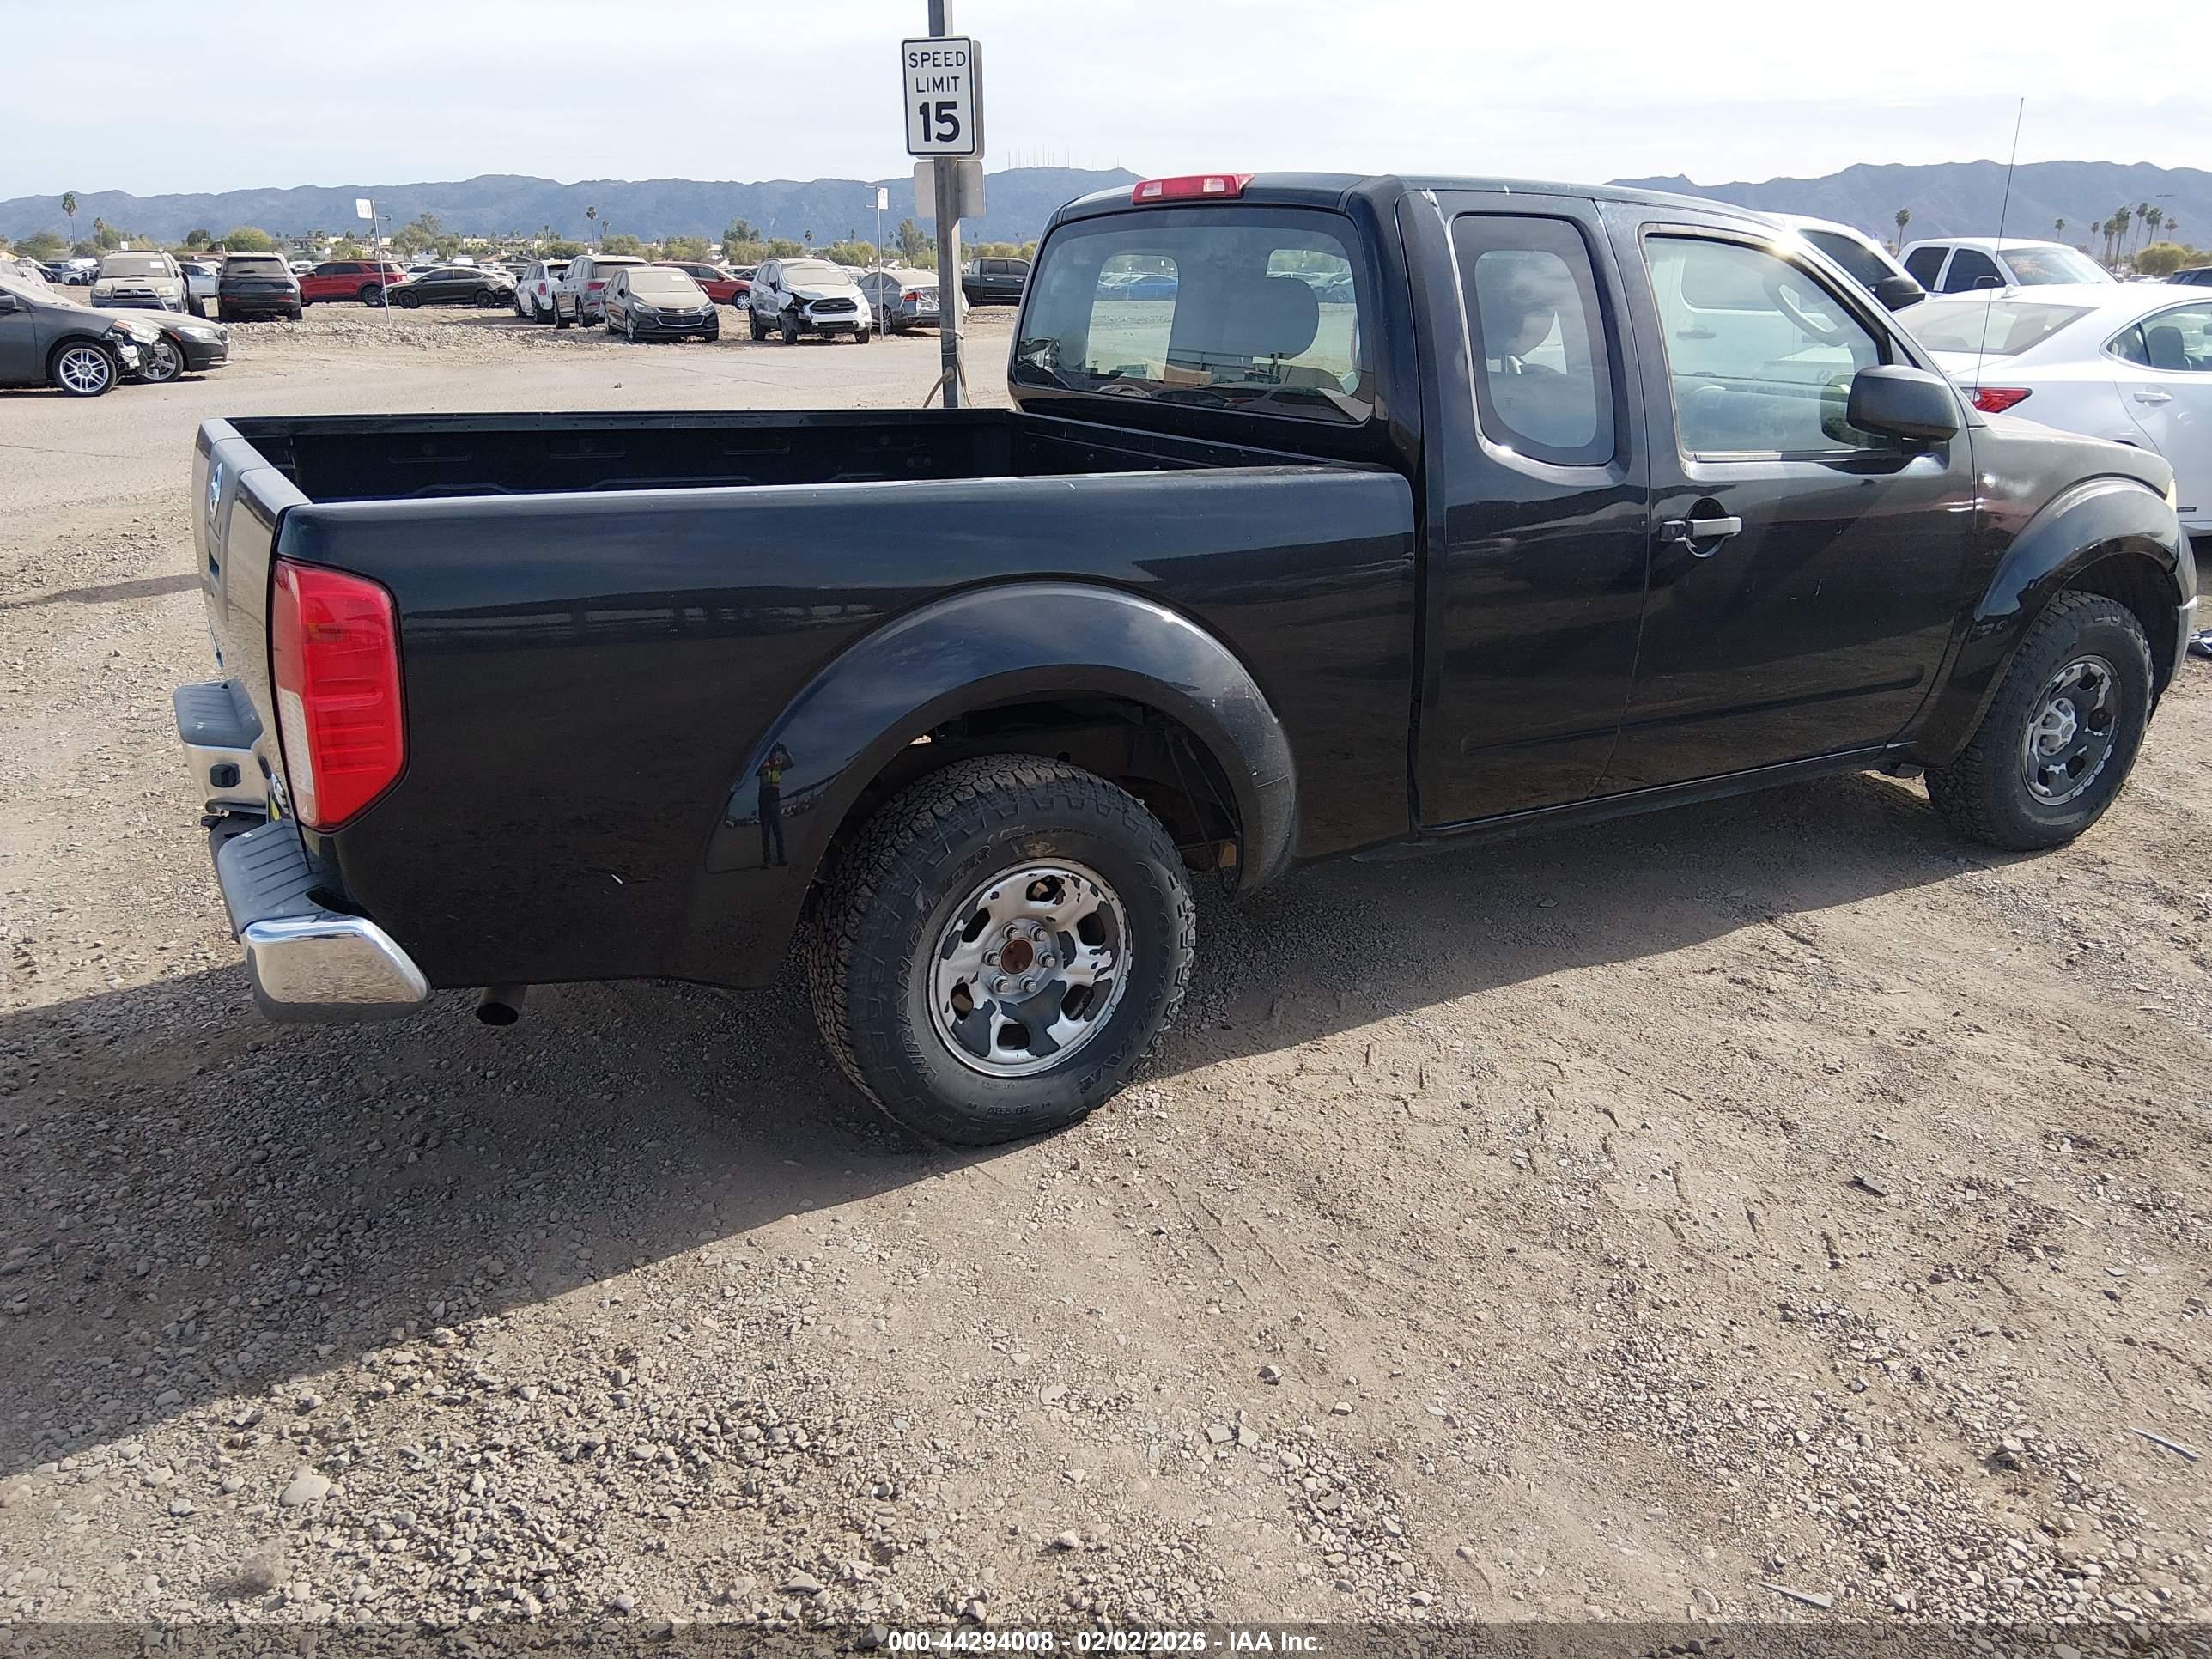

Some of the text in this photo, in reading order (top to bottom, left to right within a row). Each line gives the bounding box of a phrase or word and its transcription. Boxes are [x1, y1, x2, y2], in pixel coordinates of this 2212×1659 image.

[908, 51, 966, 69] SPEED
[915, 76, 960, 93] LIMIT
[919, 101, 961, 142] 15
